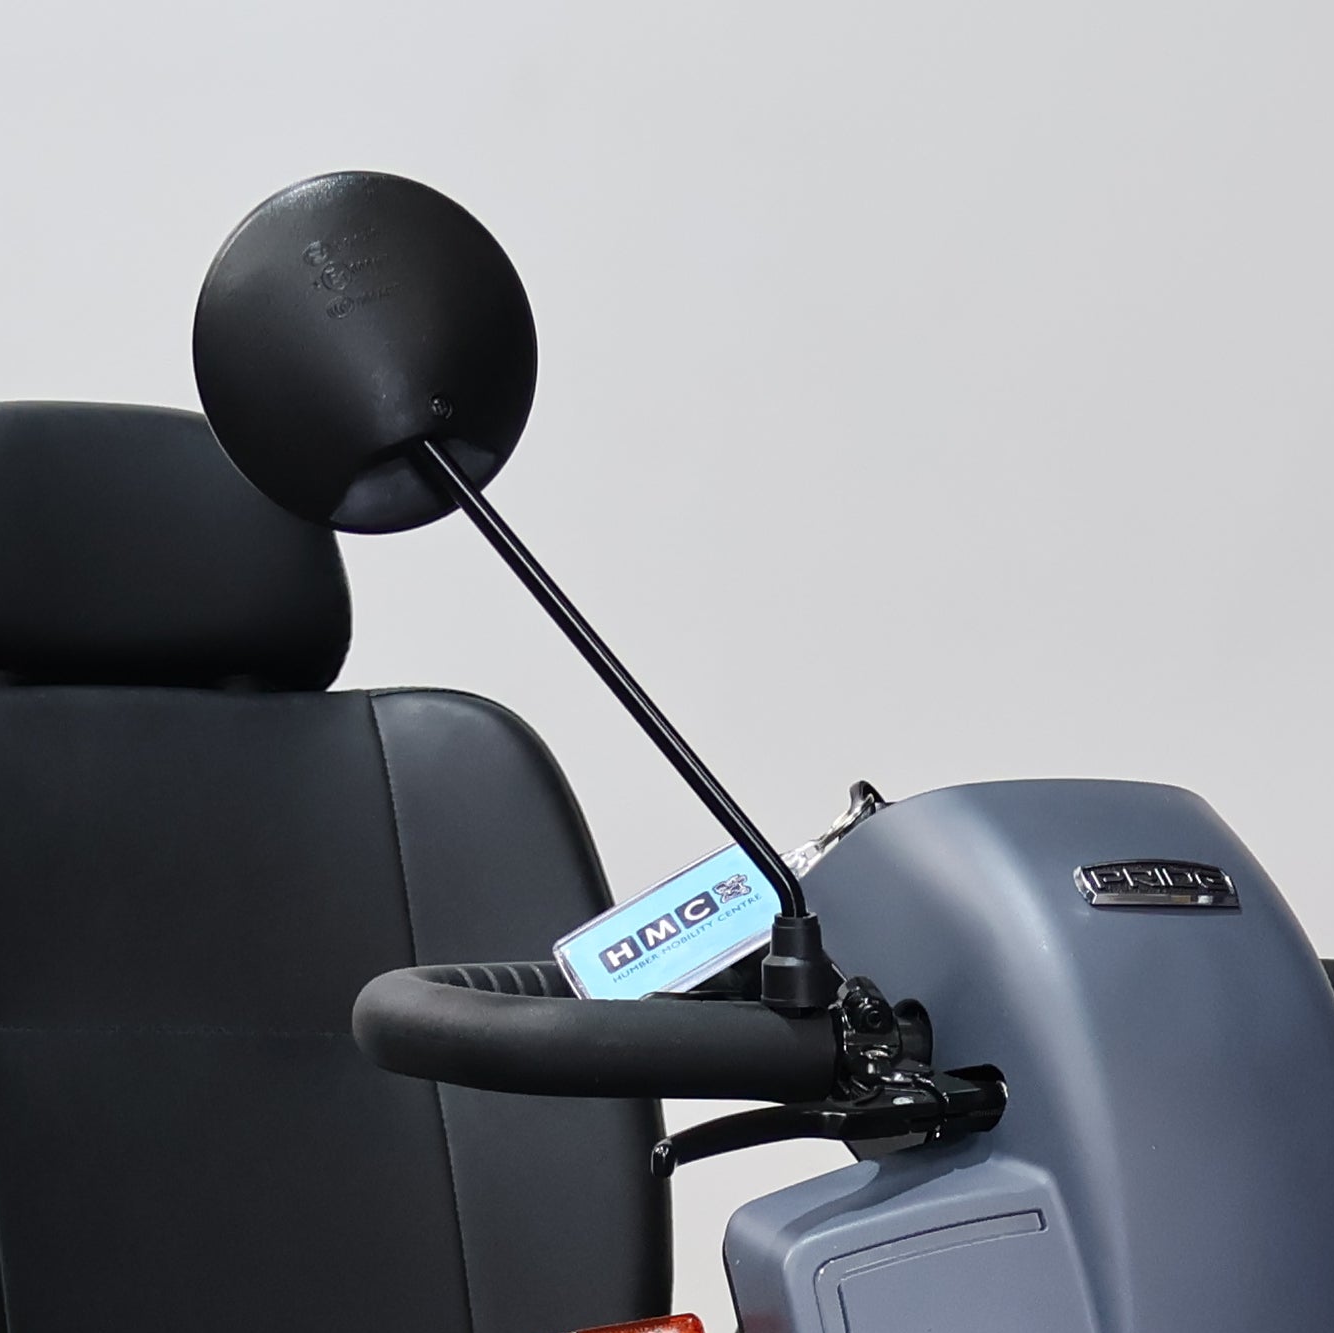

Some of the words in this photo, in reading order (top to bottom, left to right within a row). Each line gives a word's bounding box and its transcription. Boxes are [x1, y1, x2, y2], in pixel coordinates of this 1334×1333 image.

[603, 895, 714, 970] HMC
[612, 953, 660, 984] HUMBER
[661, 920, 714, 955] MOBILITY
[717, 892, 763, 922] CENTRE
